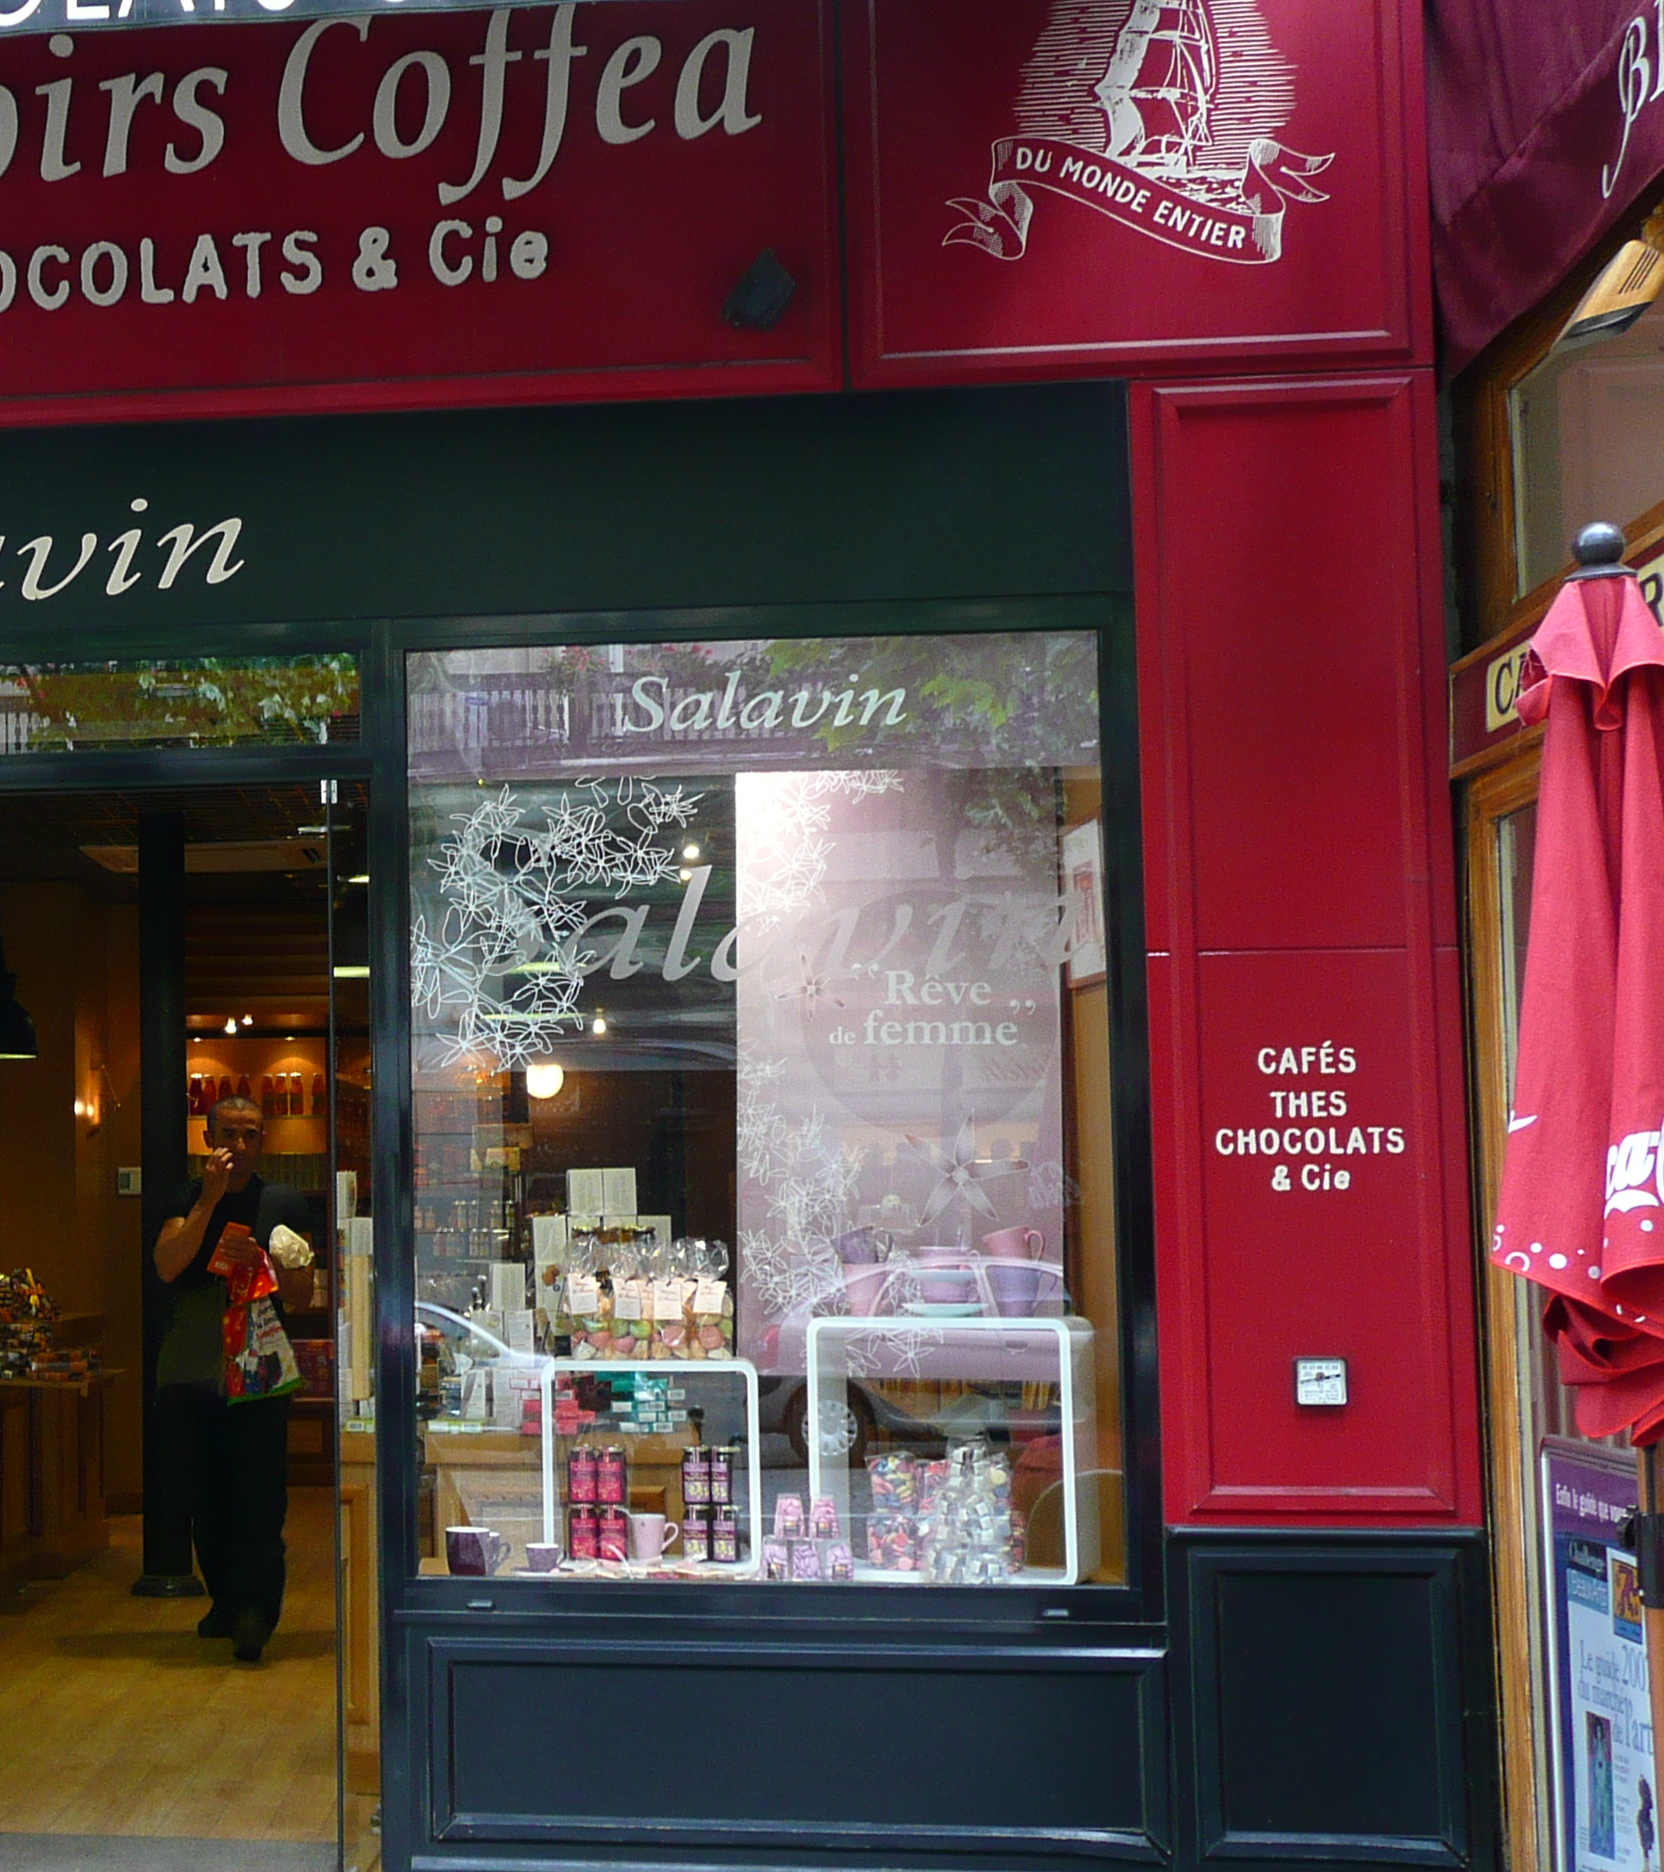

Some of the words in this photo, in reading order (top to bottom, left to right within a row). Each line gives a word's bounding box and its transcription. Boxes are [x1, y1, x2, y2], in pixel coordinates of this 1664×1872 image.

[276, 4, 762, 206] Coffea
[1015, 147, 1053, 173] DU
[1059, 156, 1152, 213] MONDE
[1152, 200, 1247, 250] ENTIER
[352, 226, 398, 292] &
[428, 216, 549, 286] Cie
[622, 672, 907, 733] Salavin
[828, 1026, 857, 1046] de
[862, 1009, 1019, 1046] femme
[1257, 1040, 1357, 1075] CAFÉS
[1269, 1090, 1348, 1118] THES
[1215, 1126, 1405, 1156] CHOCOLATS
[1271, 1164, 1291, 1192] &
[1301, 1163, 1351, 1191] Cie
[1579, 1639, 1594, 1673] Le
[1596, 1650, 1620, 1685] guide
